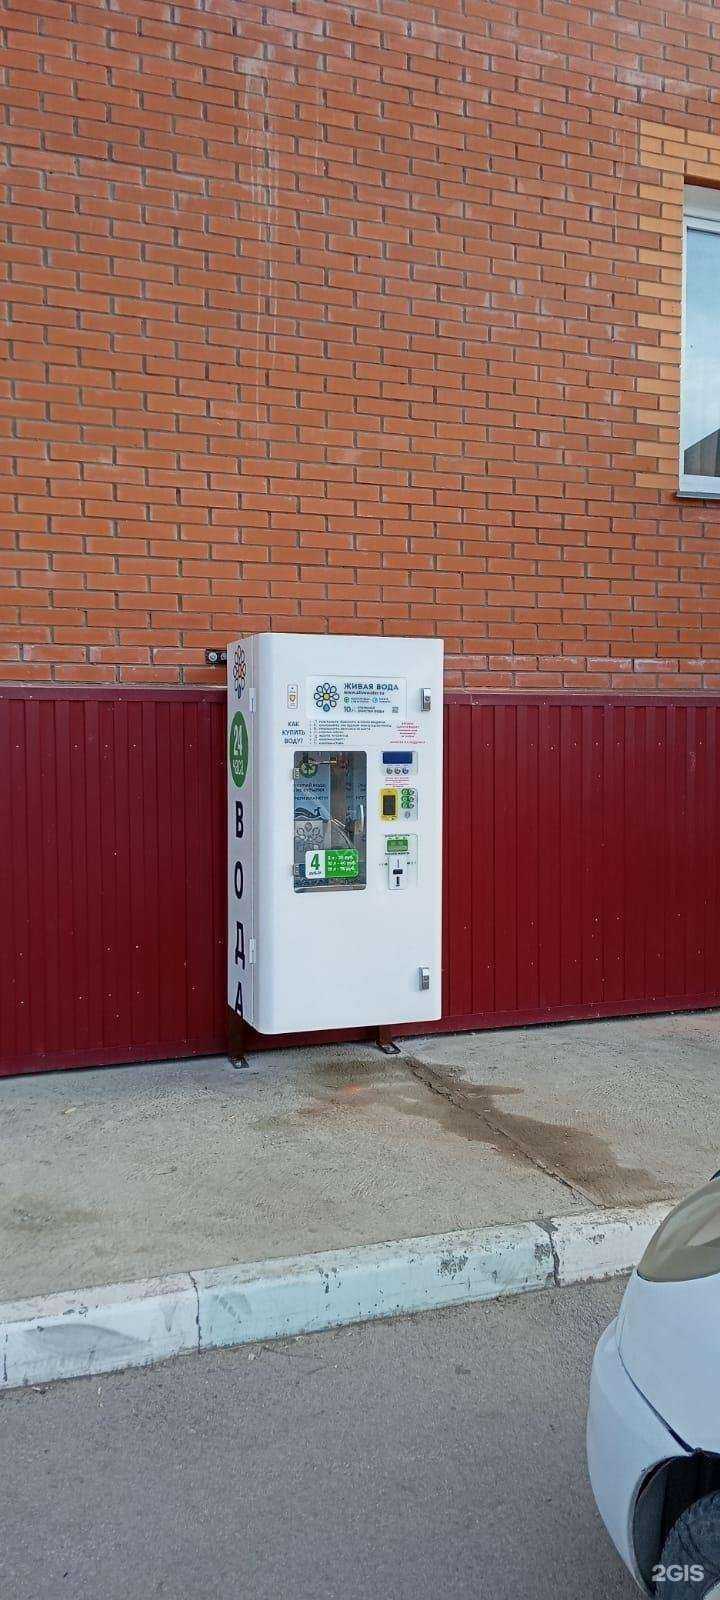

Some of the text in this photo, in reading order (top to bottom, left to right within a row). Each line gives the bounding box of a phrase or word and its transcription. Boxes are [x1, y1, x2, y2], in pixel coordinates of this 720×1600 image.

[234, 724, 242, 756] 24
[310, 854, 320, 870] 4
[234, 800, 245, 1018] ВОДА
